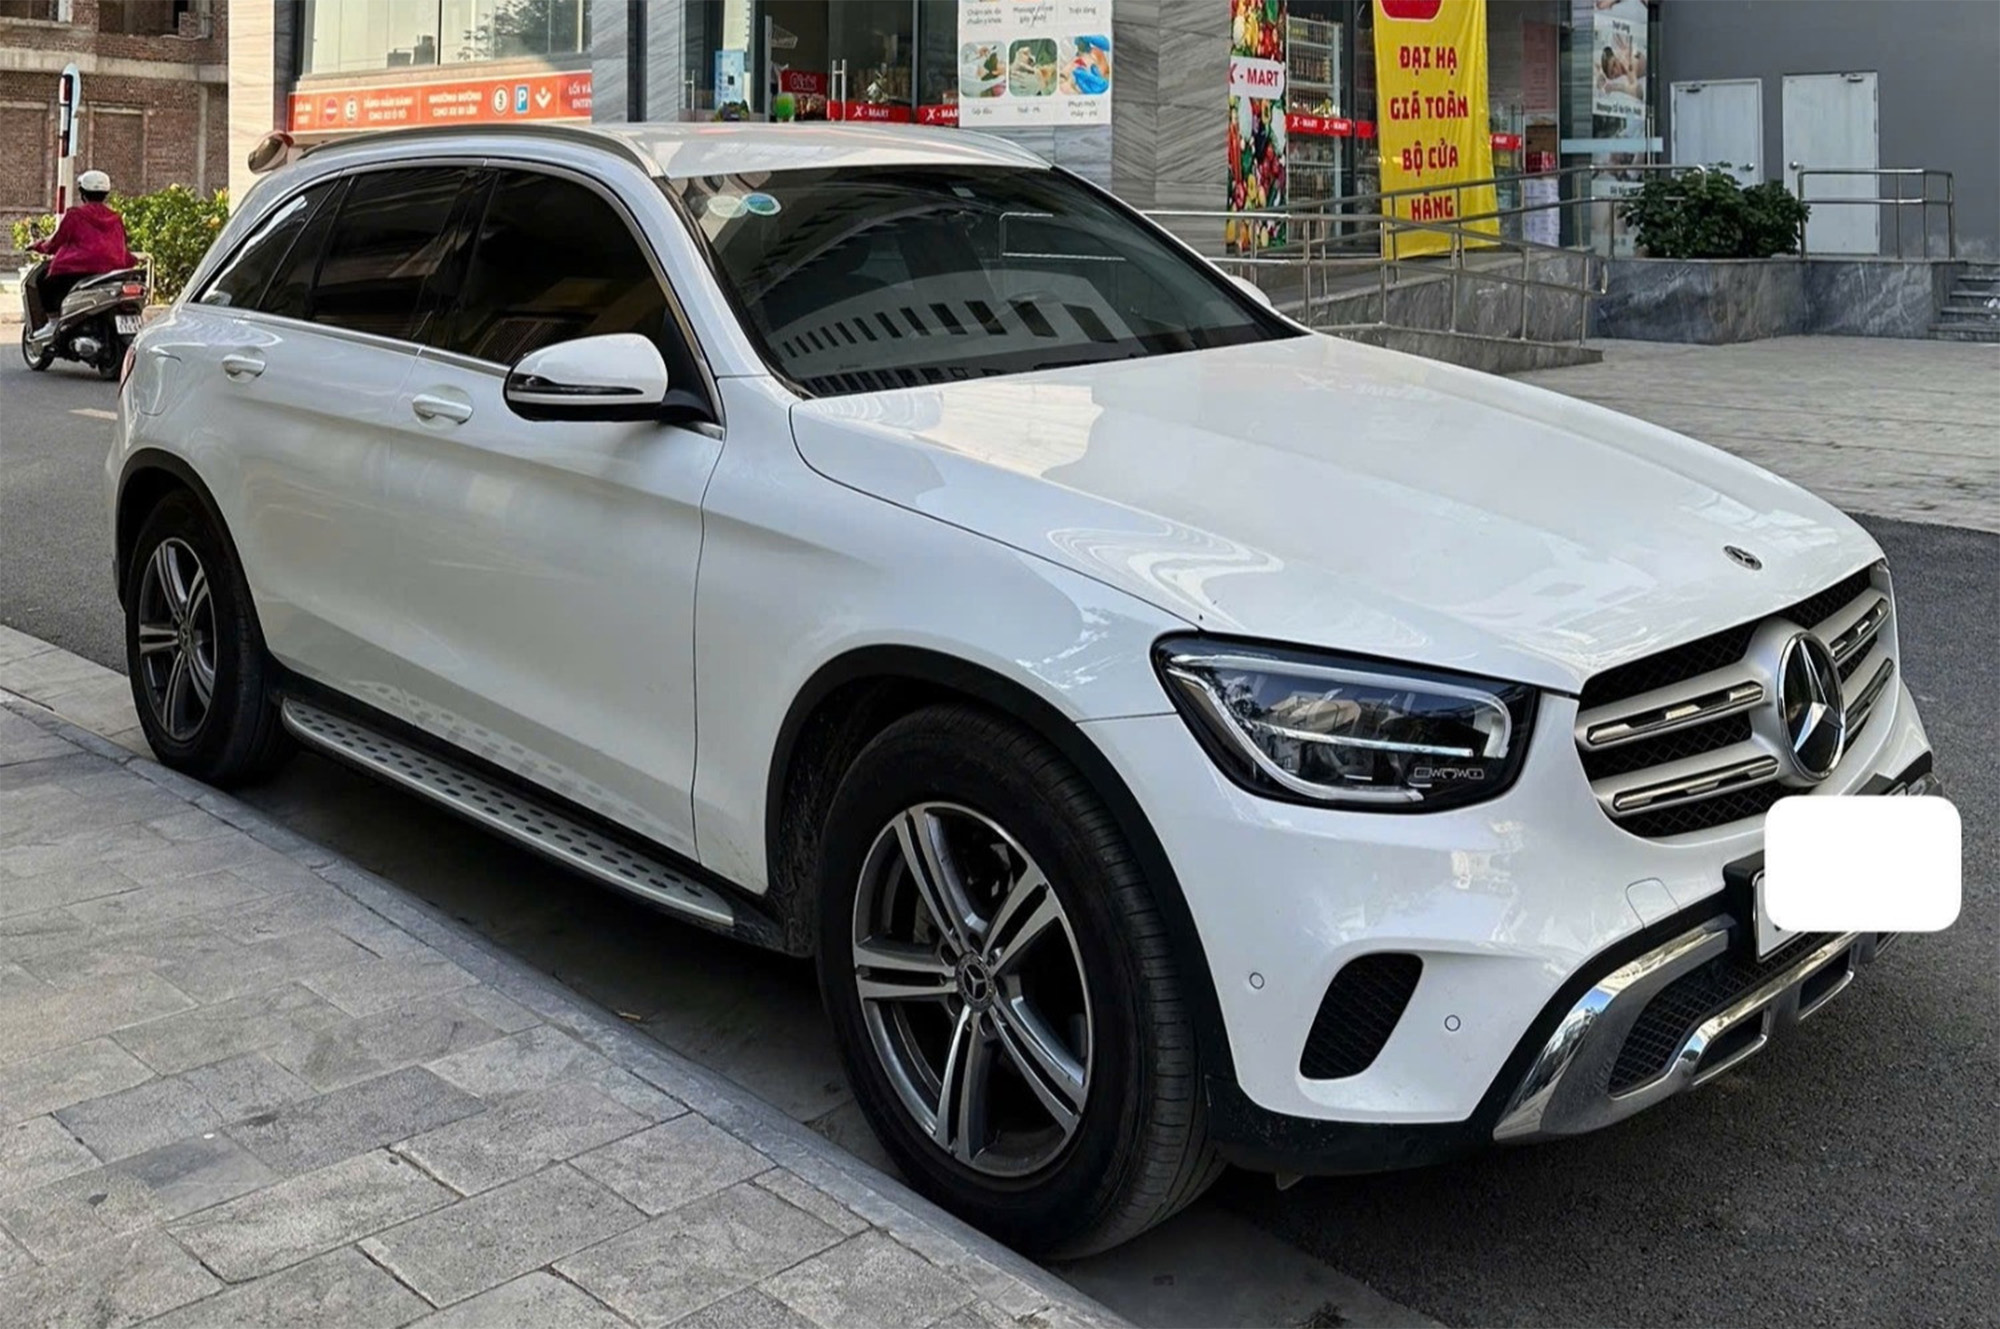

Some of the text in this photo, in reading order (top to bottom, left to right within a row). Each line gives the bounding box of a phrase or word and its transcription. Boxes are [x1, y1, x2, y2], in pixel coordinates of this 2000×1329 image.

[1399, 45, 1458, 76] ĐẠI HẠ
[1247, 67, 1279, 87] MART
[853, 105, 863, 117] X
[868, 108, 890, 118] MART
[1390, 89, 1469, 120] GIÁ TOÀN
[926, 108, 936, 120] X
[1292, 116, 1298, 127] X
[1302, 119, 1318, 128] MART
[1323, 119, 1330, 130] X
[1402, 138, 1459, 177] BỘ CỬA
